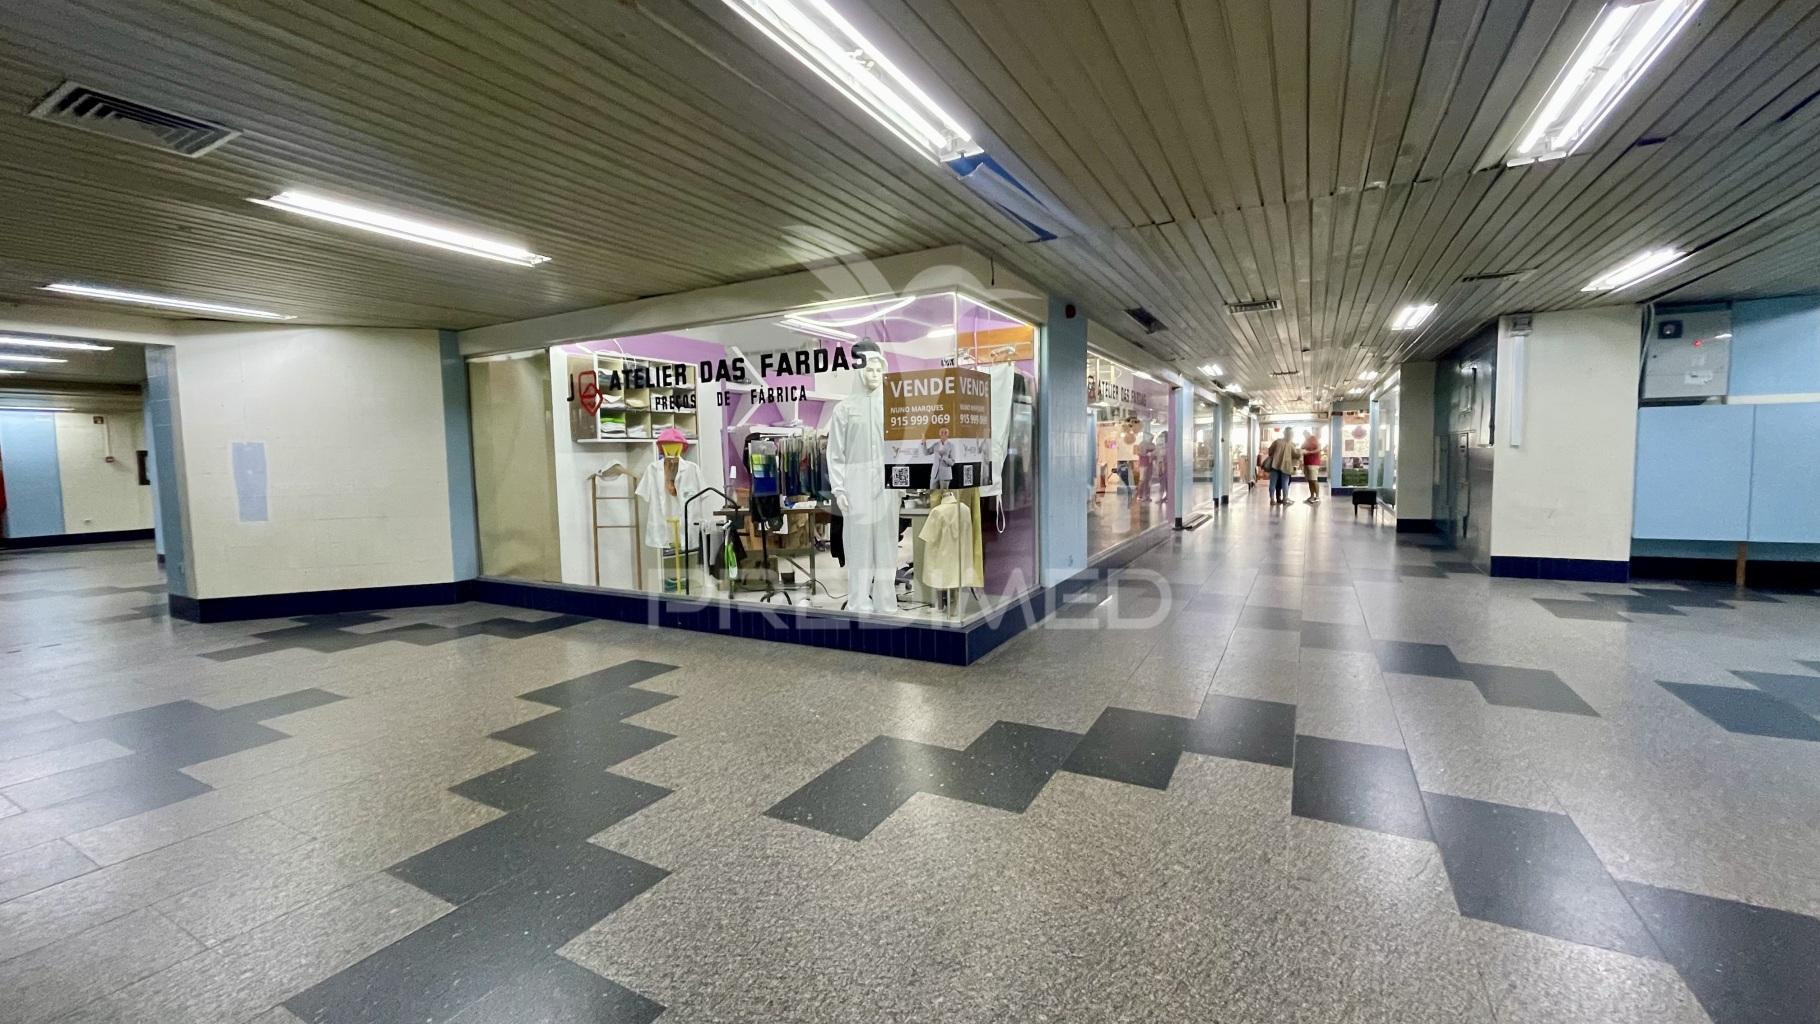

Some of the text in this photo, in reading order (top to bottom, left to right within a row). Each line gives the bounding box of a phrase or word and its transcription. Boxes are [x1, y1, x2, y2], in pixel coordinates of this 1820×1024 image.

[609, 345, 867, 391] ATELIER DAS FARDAS
[716, 391, 731, 407] DE
[750, 385, 807, 405] FÁBRICA
[890, 377, 955, 398] VENDE
[960, 377, 989, 397] VENDE
[890, 404, 944, 414] NUNO MARQUES
[890, 414, 951, 427] 915 999 069
